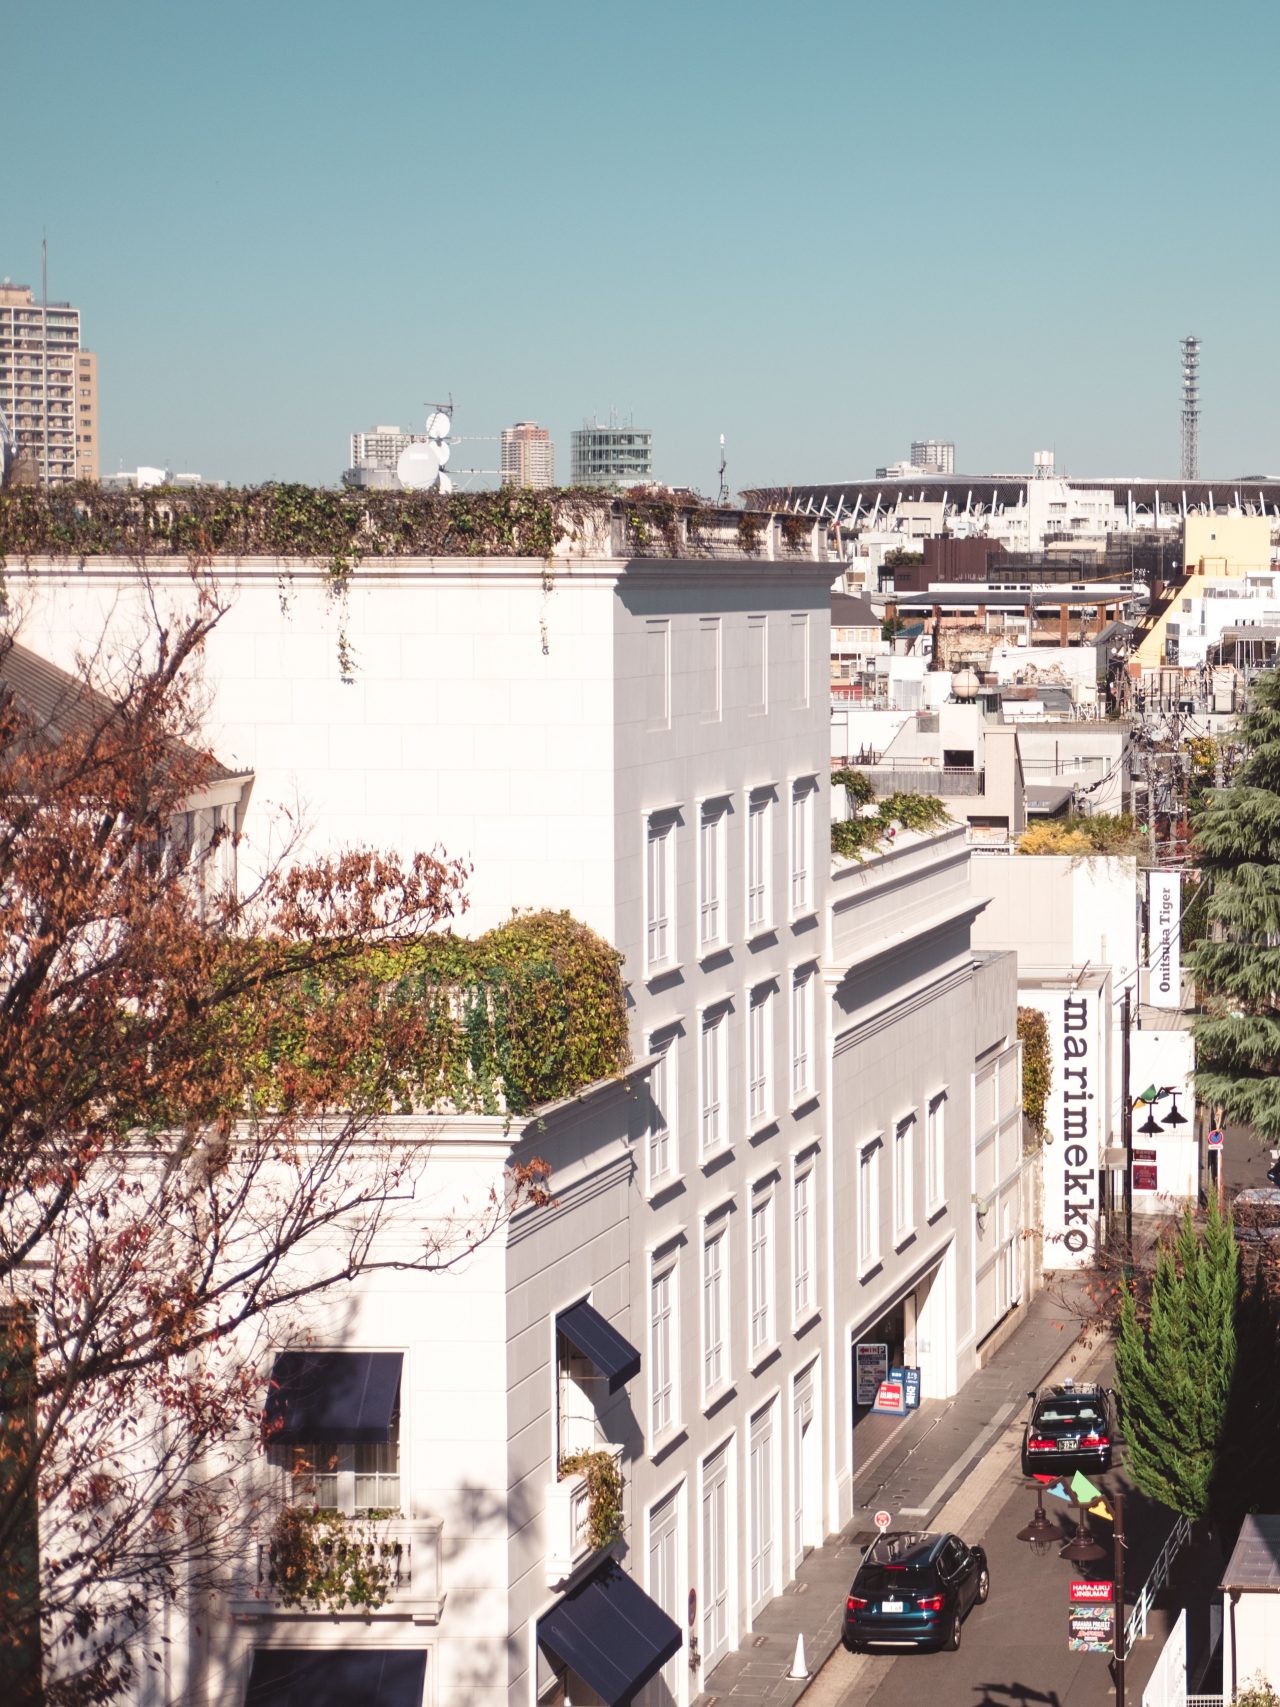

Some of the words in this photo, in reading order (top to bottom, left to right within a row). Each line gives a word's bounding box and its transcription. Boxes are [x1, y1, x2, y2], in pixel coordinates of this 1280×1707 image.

[1159, 888, 1173, 925] Tiger
[1159, 928, 1171, 992] Onitsuka
[1063, 998, 1095, 1253] marimekko
